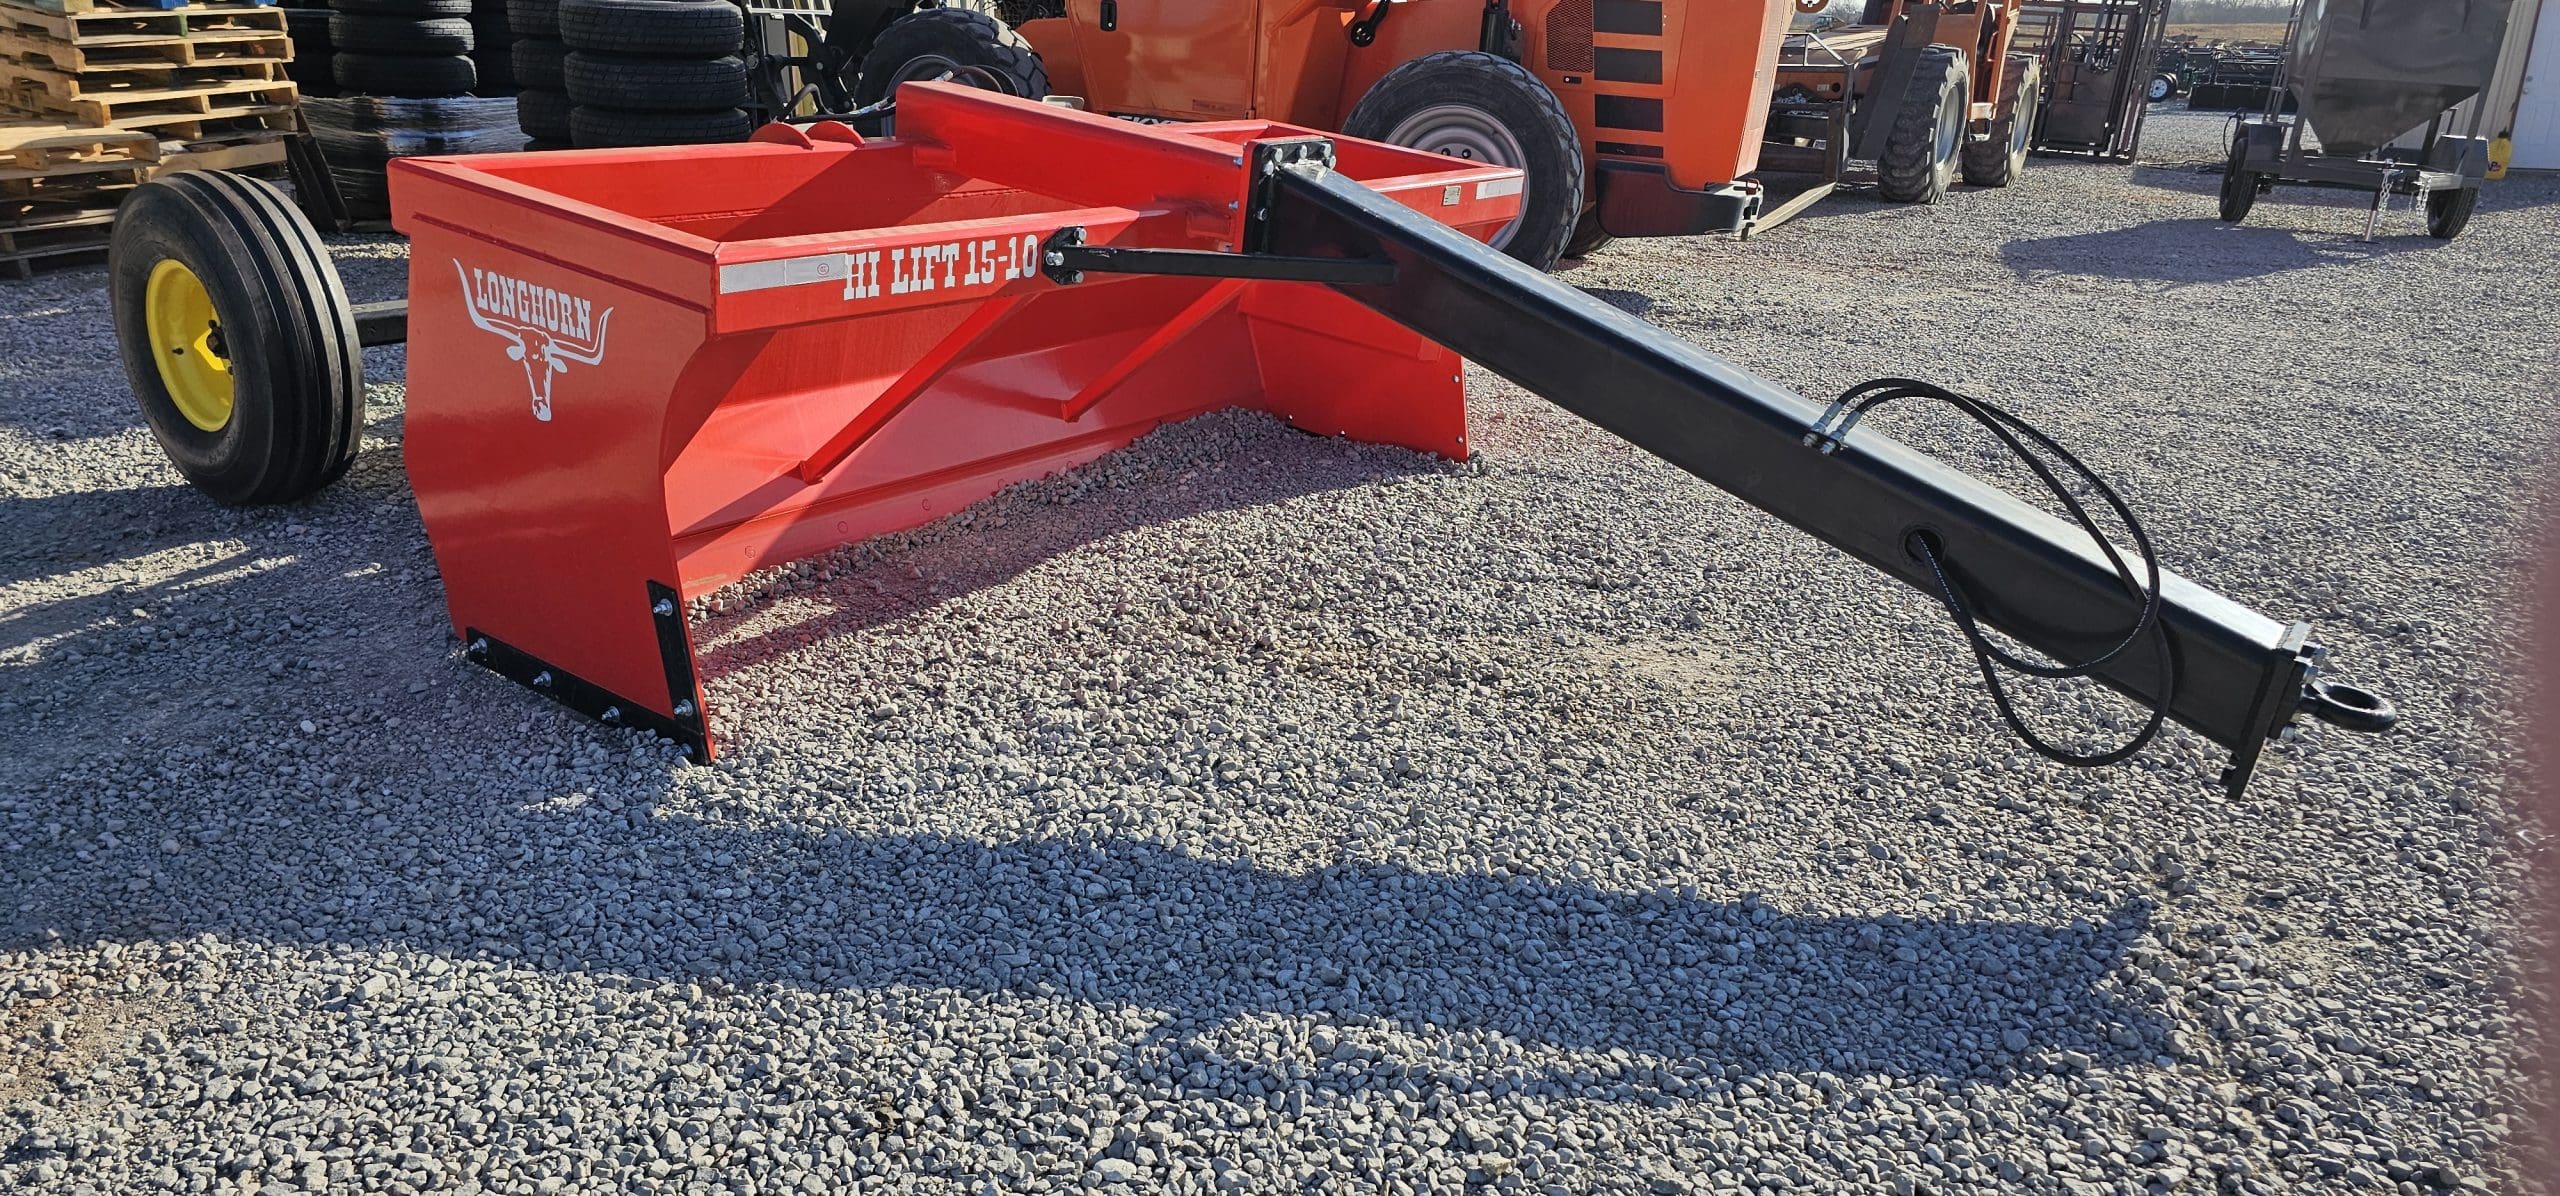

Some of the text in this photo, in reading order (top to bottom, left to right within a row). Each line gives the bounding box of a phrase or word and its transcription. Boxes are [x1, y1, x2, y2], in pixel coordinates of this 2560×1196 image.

[844, 234, 1038, 300] HI LIFT 15-10
[473, 267, 592, 342] LONGHORN
